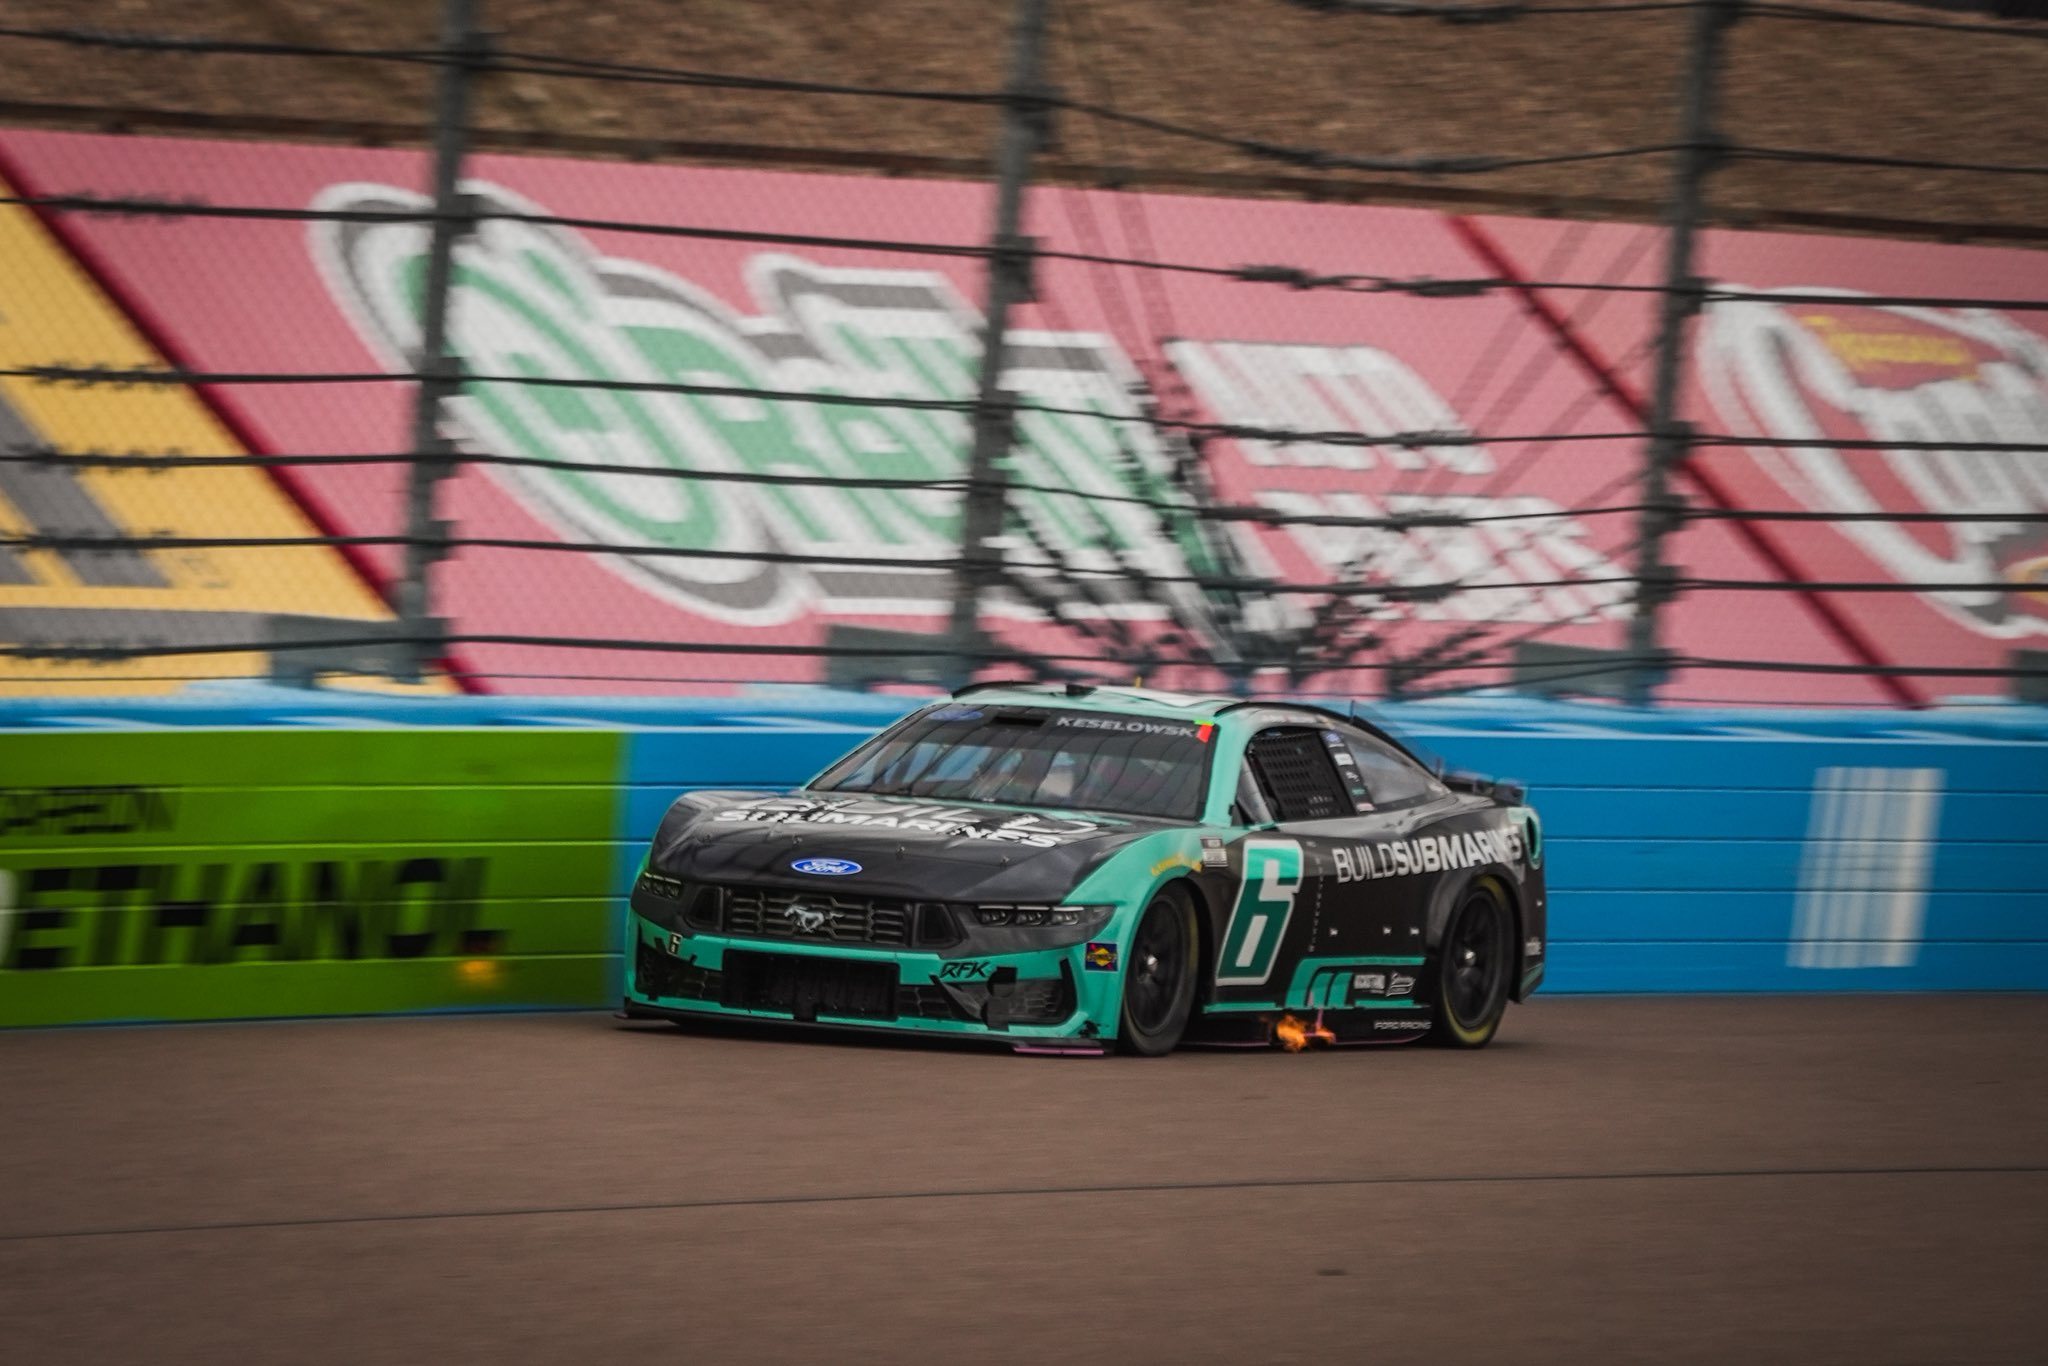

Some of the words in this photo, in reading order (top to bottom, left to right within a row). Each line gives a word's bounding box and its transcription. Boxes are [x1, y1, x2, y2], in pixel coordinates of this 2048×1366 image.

[1056, 717, 1199, 737] KESELOWSK
[13, 857, 509, 970] ETHANOL
[1215, 839, 1304, 987] 6
